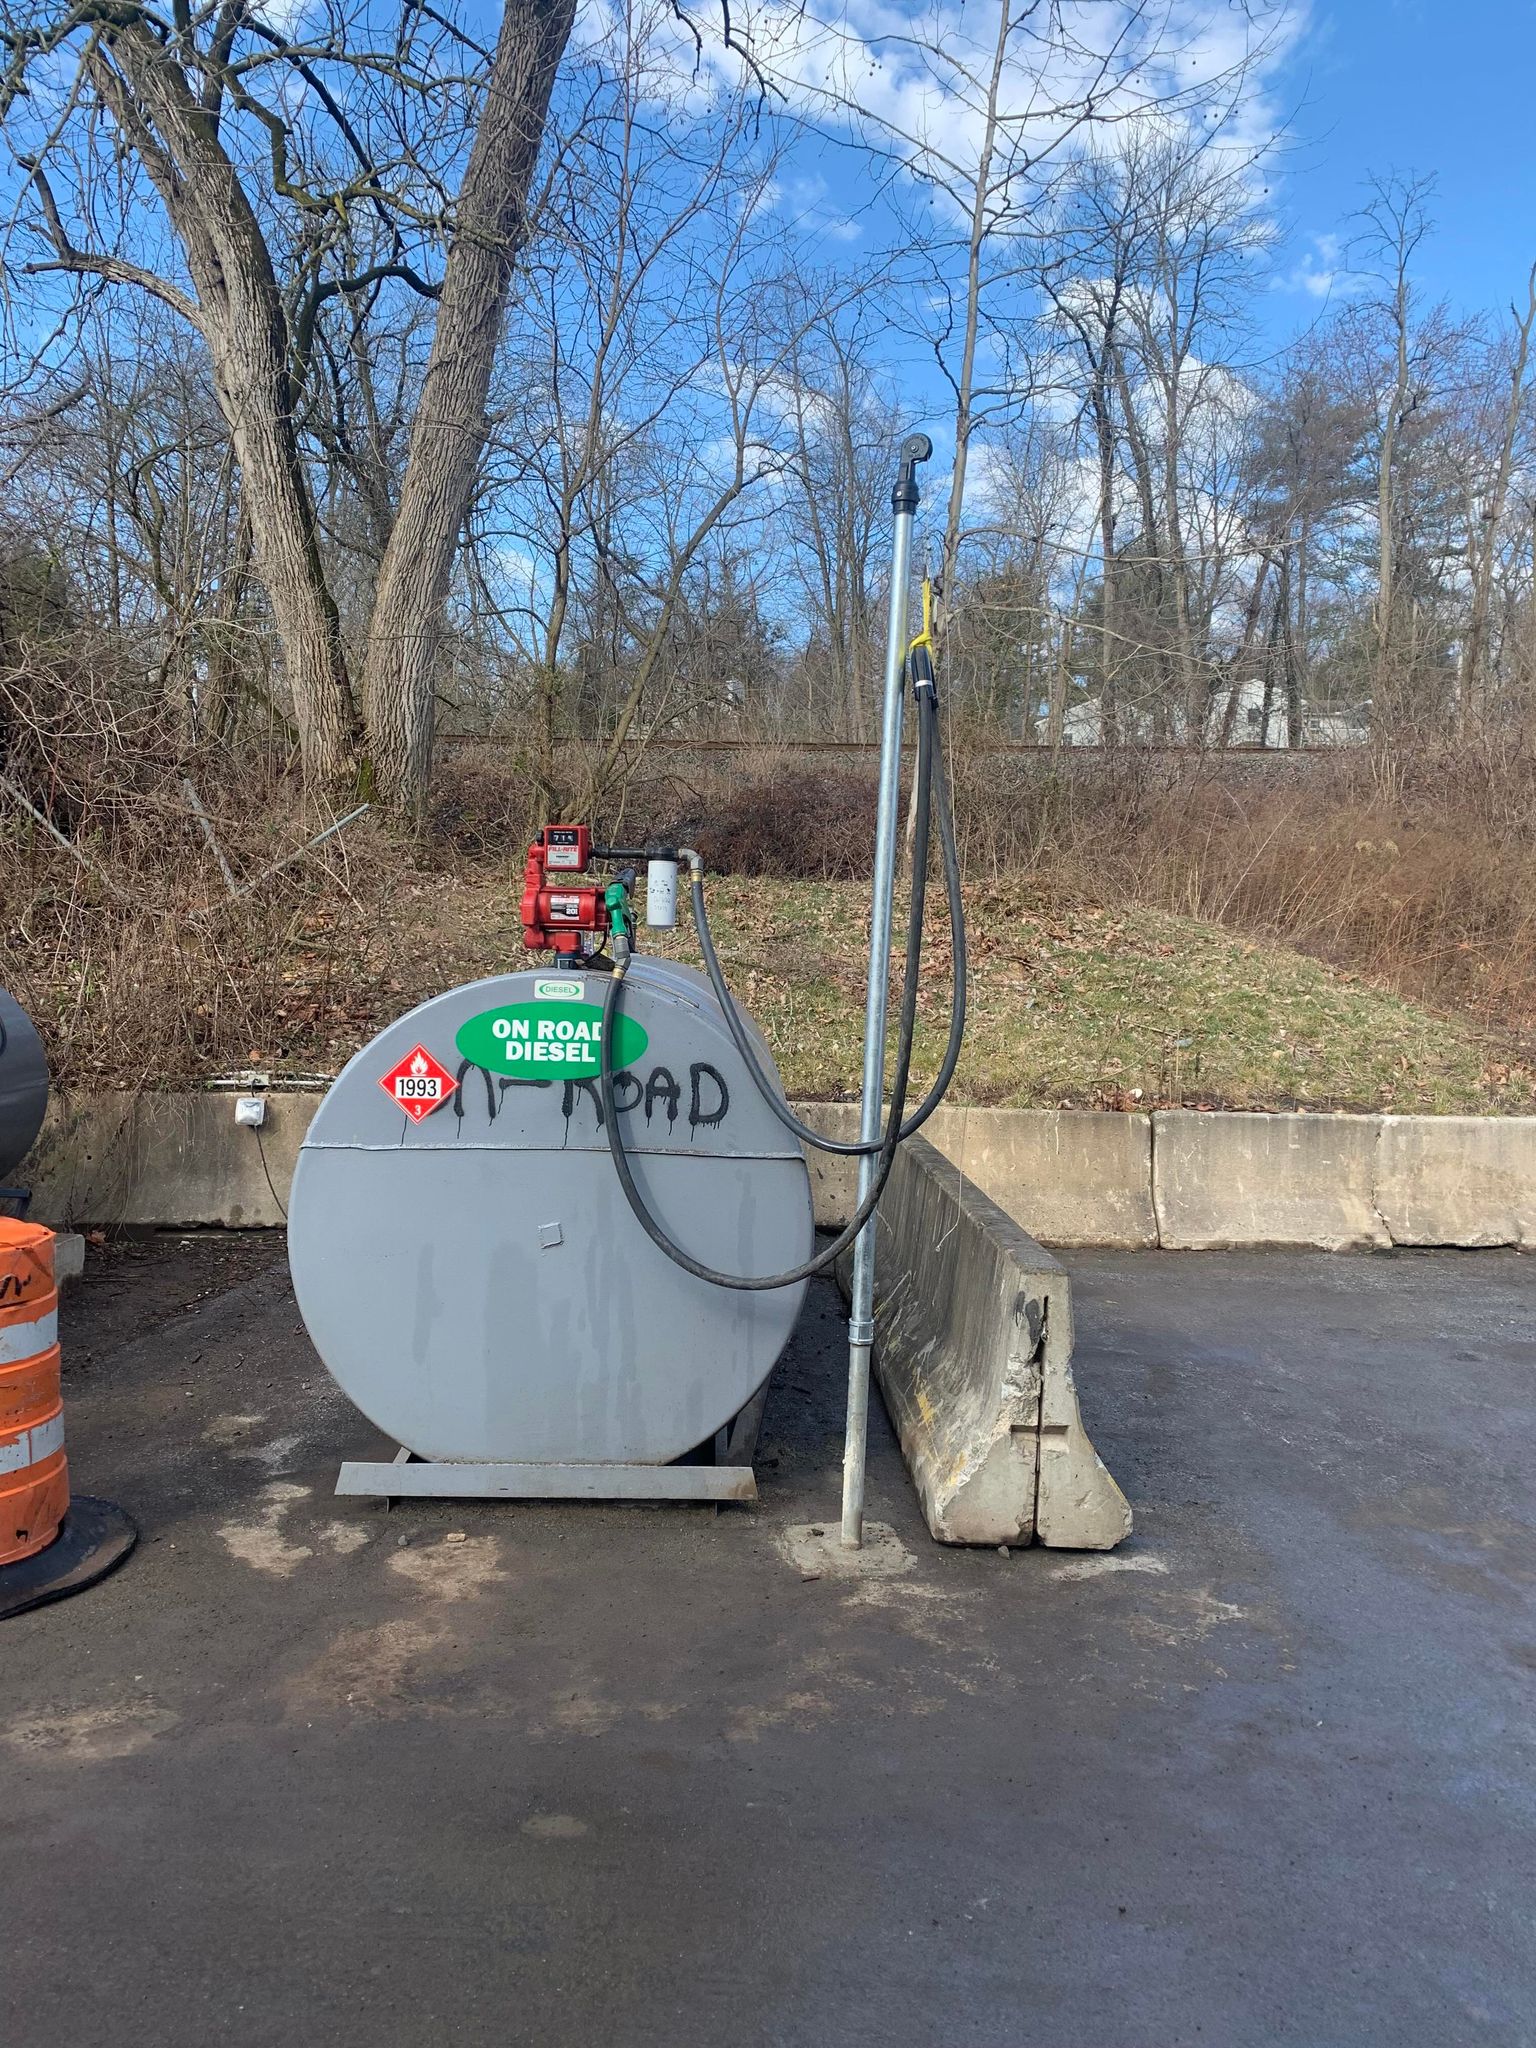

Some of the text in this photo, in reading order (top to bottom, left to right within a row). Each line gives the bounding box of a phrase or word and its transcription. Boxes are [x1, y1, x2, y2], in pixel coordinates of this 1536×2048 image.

[545, 986, 574, 994] DIESEL
[491, 1018, 530, 1039] ON
[505, 1040, 596, 1063] DIESEL
[398, 1078, 438, 1097] 1993
[414, 1104, 422, 1116] 3
